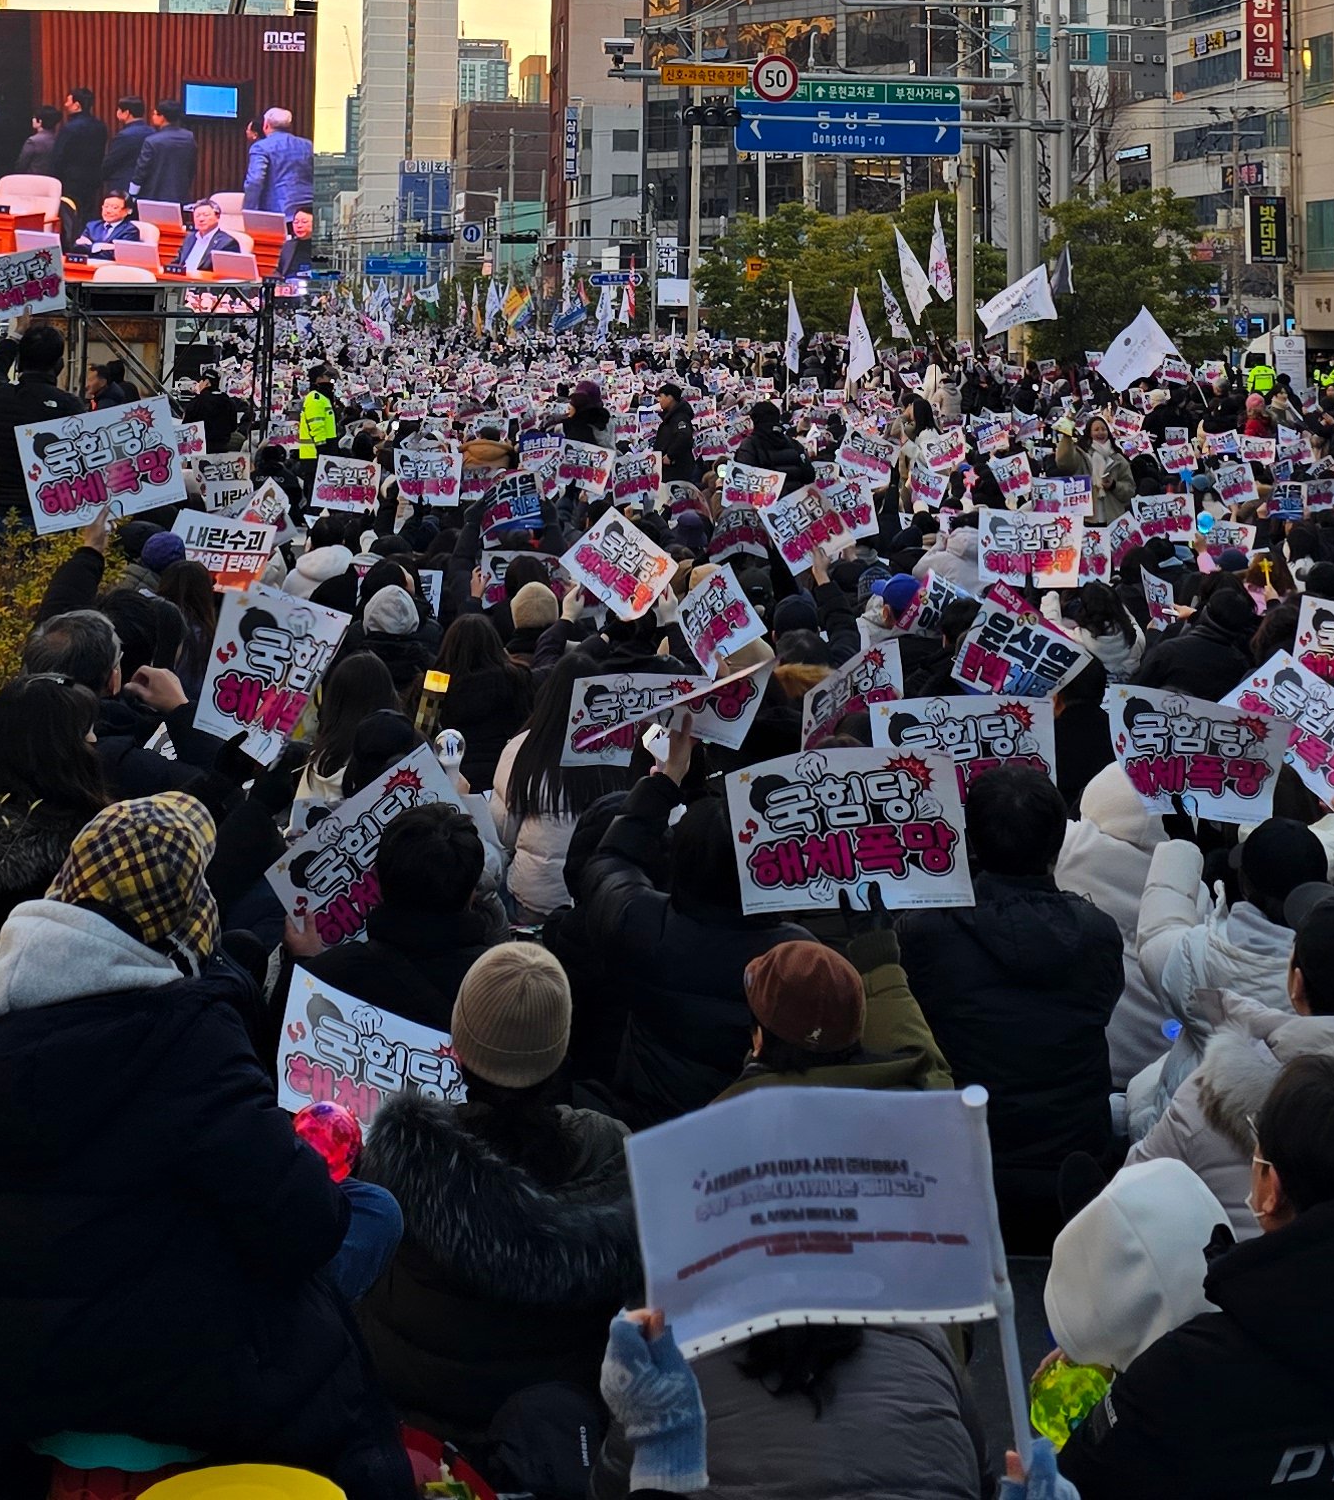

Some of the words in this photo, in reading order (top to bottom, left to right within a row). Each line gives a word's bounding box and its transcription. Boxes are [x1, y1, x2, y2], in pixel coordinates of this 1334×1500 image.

[264, 31, 306, 44] MBC
[764, 70, 787, 88] 50
[828, 85, 875, 99] 문현교차로
[895, 87, 943, 100] 부전사거리
[1259, 205, 1277, 256] 밧데리
[44, 416, 150, 478] 국힘당
[565, 447, 607, 468] 국힘당
[36, 446, 173, 517] 해체폭망
[327, 462, 376, 486] 국힘당
[401, 457, 454, 478] 국힘당
[617, 458, 655, 483] 국힘당
[734, 472, 776, 493] 국힘당
[773, 493, 823, 542] 국힘당
[186, 525, 267, 551] 내란수괴
[994, 520, 1067, 551] 국힘당
[600, 531, 662, 584] 국힘당
[982, 548, 1078, 576] 해체폭망
[977, 612, 1081, 686] 윤석열
[1129, 711, 1259, 758] 국힘당
[1125, 755, 1272, 799] 해체폭망
[765, 769, 923, 835] 국힘당
[748, 820, 959, 890] 해체폭망
[313, 1014, 469, 1103] 국힘당
